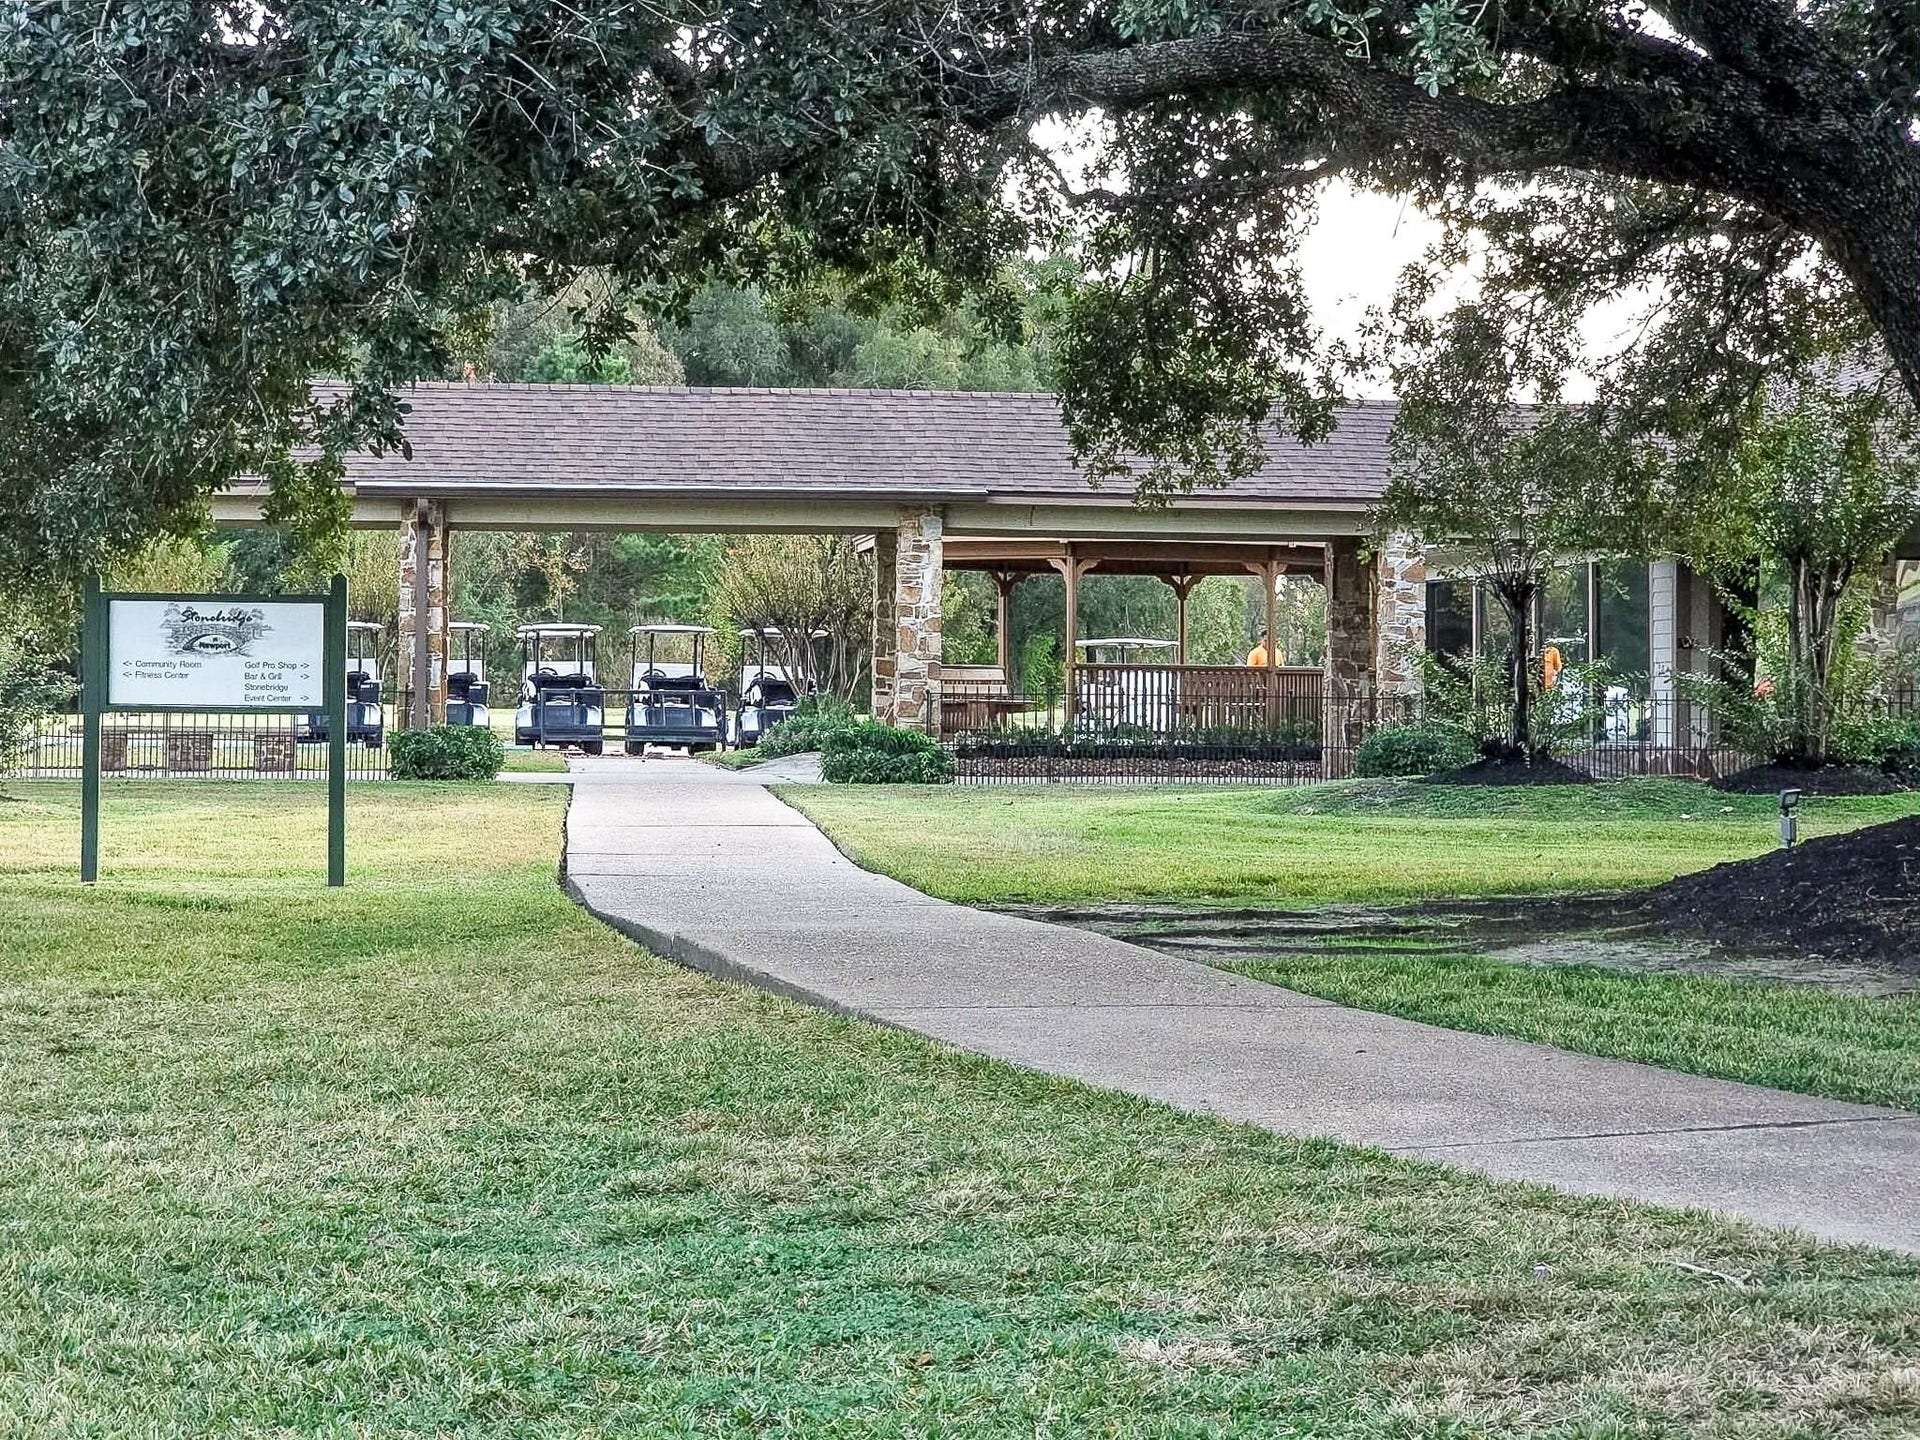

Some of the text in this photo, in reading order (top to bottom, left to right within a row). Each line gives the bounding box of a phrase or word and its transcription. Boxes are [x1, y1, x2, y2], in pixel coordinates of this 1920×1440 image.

[181, 609, 253, 627] Stonebridge
[199, 642, 230, 650] Newport
[135, 660, 202, 669] Community Room
[244, 661, 297, 671] Golf Pro Shop
[135, 670, 189, 679] Fitness Center
[244, 672, 282, 680] Bar & Grill
[244, 682, 289, 692] Stonebridge
[244, 693, 292, 702] Event Center
